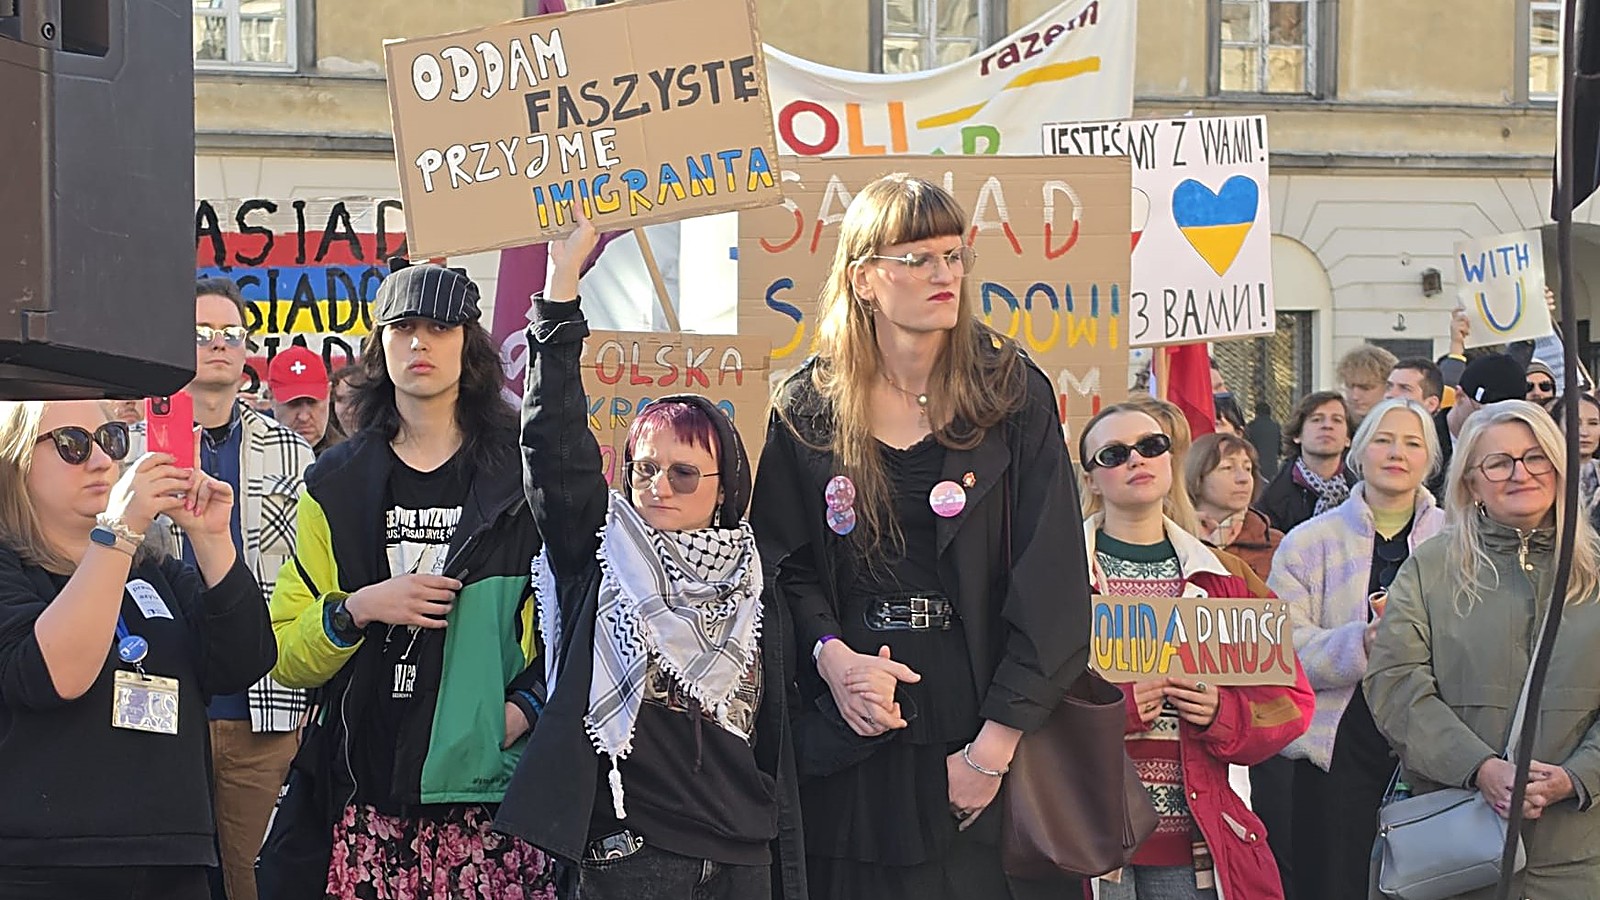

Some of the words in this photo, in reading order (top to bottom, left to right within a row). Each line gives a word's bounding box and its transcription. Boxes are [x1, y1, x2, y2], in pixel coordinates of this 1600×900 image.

[412, 28, 569, 101] ODDAM
[525, 55, 760, 133] FASZYSTĘ
[779, 100, 908, 156] OLI
[1172, 121, 1187, 166] Z
[1199, 118, 1266, 166] WAMI!
[415, 128, 621, 193] PRZYJMĘ
[532, 147, 775, 228] IMIGRANTA
[196, 199, 408, 268] ASIAD
[1460, 243, 1530, 283] WITH
[1163, 283, 1268, 339] ВАМИ!
[1475, 277, 1526, 337] U
[592, 340, 743, 388] OLSKA
[1095, 603, 1292, 675] OLIDARNOŚĆ
